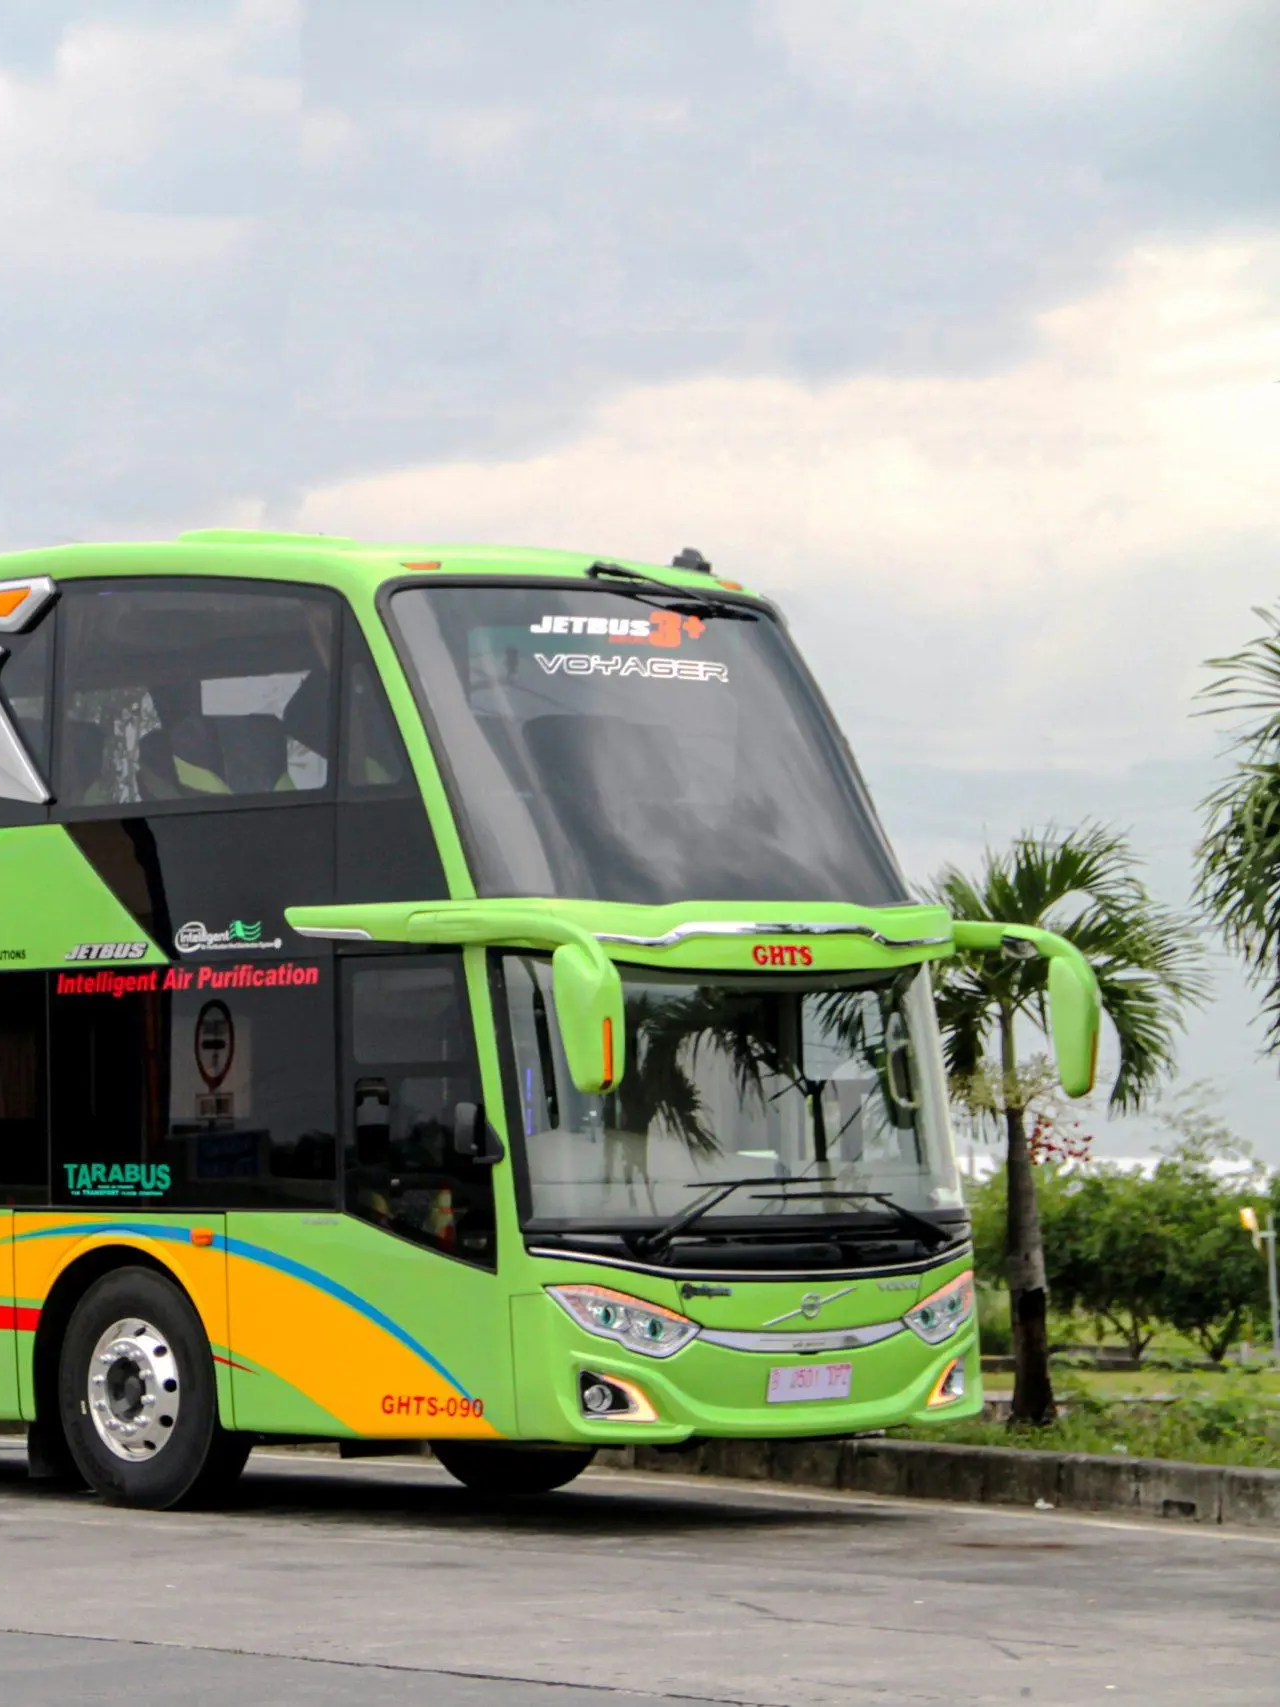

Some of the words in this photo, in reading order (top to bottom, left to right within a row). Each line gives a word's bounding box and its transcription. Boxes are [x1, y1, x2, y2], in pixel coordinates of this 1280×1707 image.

[534, 653, 729, 683] VOYAGER
[64, 942, 148, 960] JETBUS
[752, 945, 813, 966] GHTS
[57, 969, 157, 997] Intelligent
[162, 967, 194, 990] Air
[197, 963, 319, 990] Purification
[63, 1163, 172, 1190] TARABUS
[381, 1394, 484, 1418] GHTS-090
